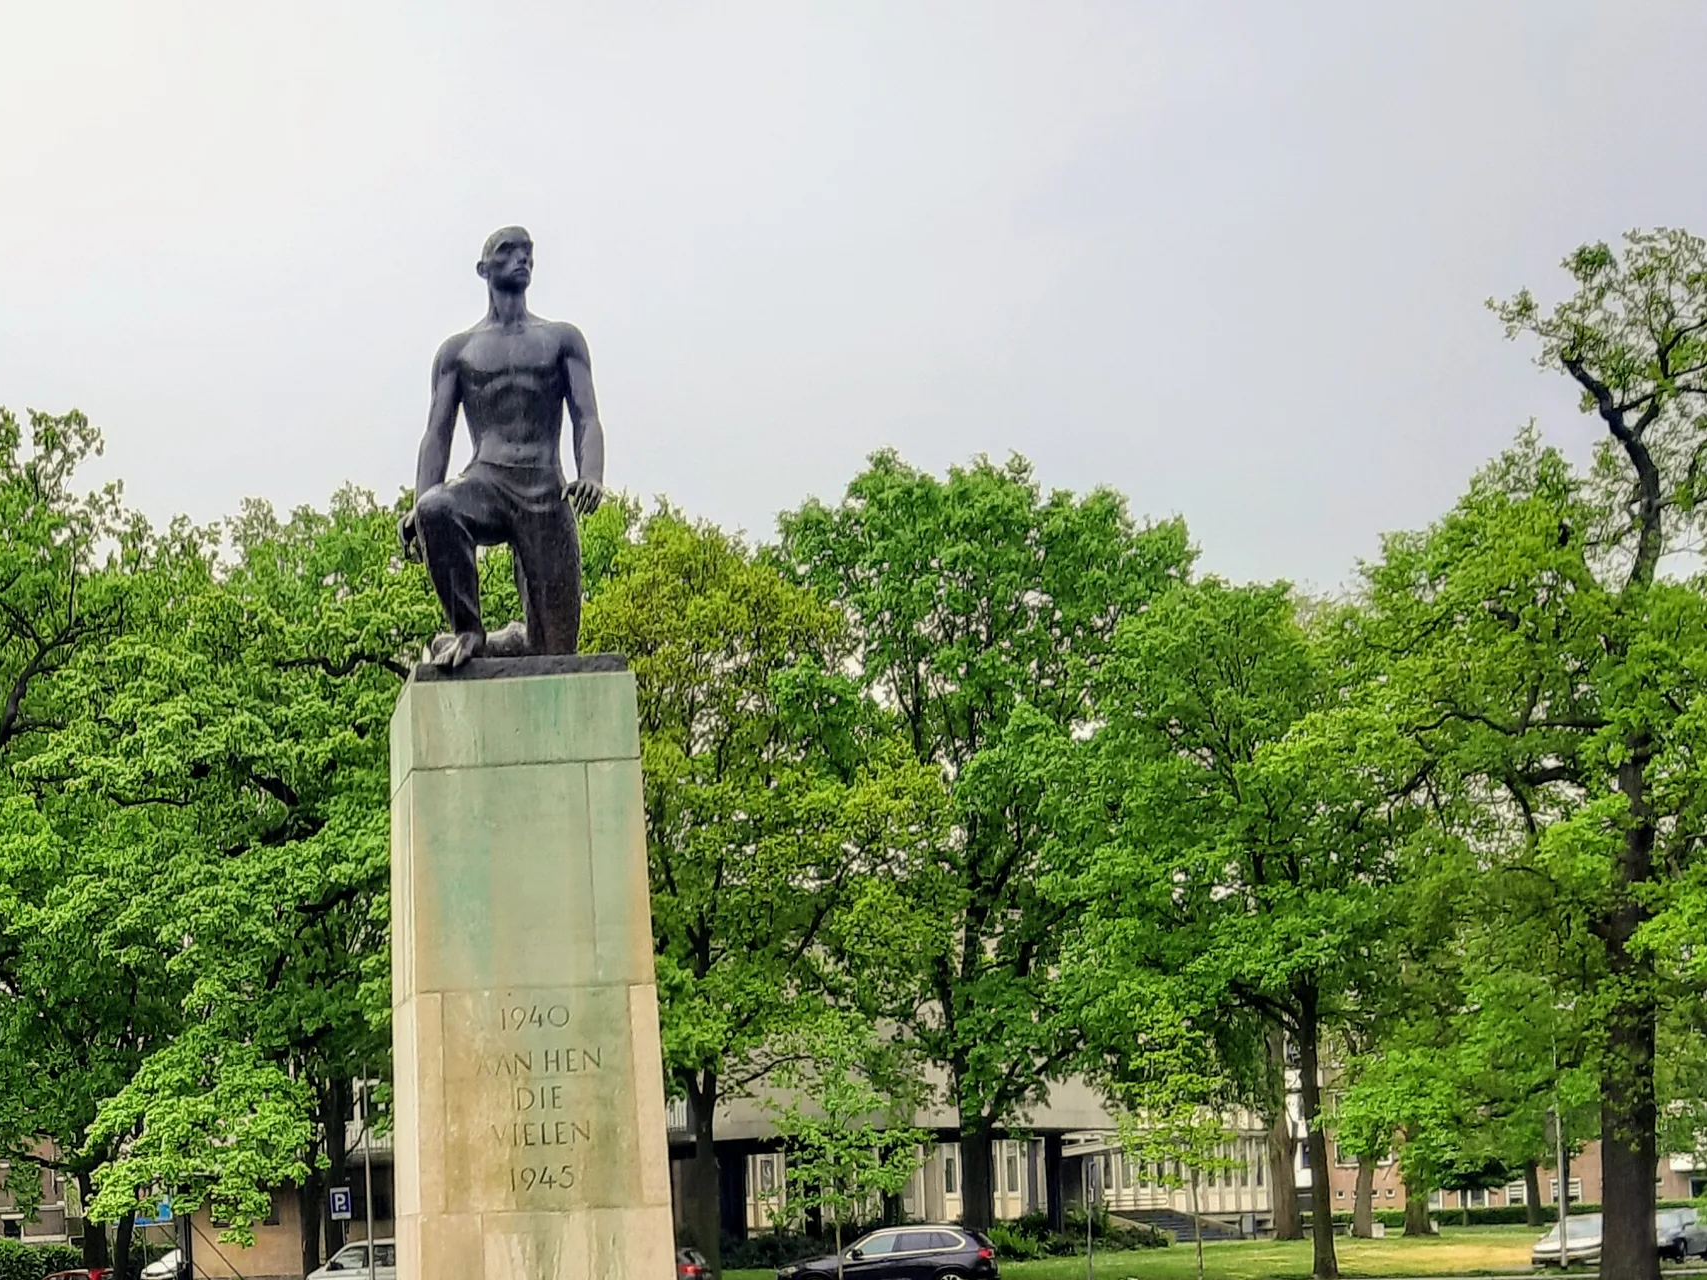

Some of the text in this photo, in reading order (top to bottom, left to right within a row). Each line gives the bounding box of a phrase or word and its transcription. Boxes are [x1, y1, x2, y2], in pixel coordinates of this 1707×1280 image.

[501, 1005, 570, 1031] 1940
[477, 1047, 602, 1076] AAN HEN
[517, 1086, 563, 1111] DIE
[492, 1120, 591, 1146] VIELEN
[509, 1165, 575, 1192] 1945
